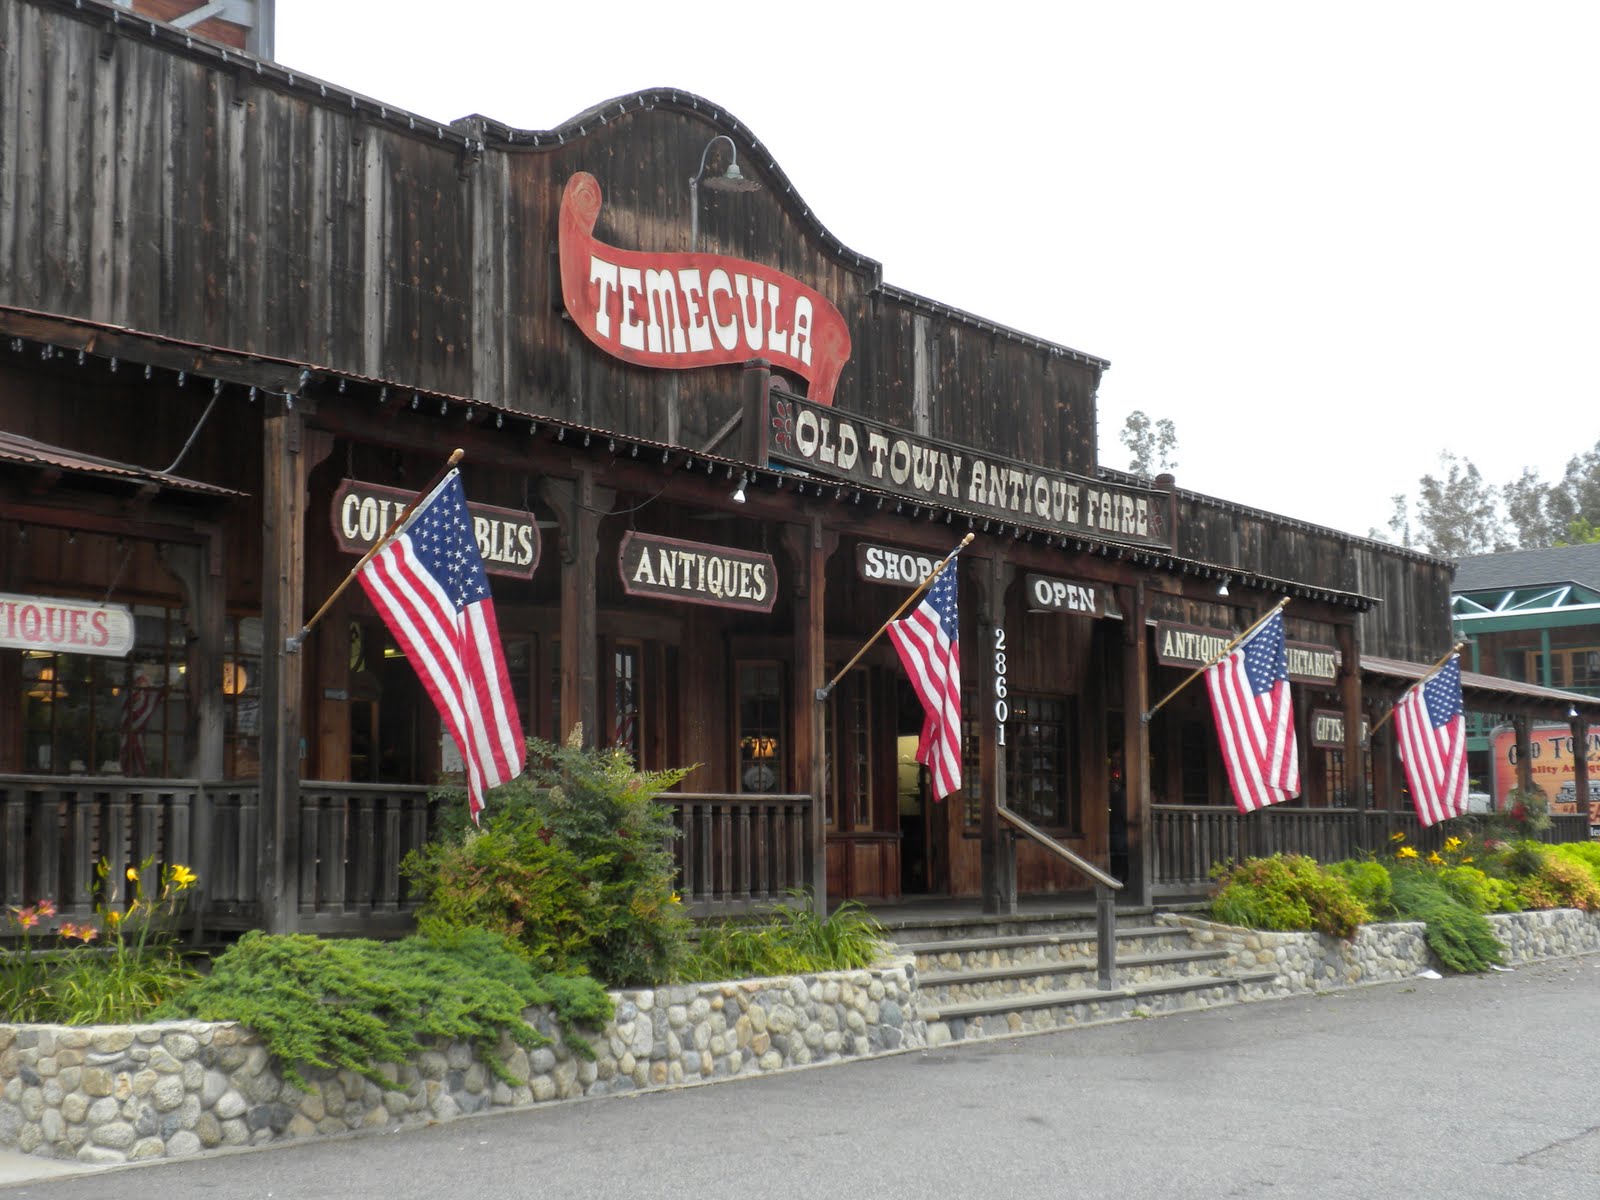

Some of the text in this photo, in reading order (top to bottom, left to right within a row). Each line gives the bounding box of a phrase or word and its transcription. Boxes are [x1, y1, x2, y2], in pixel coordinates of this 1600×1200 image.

[590, 256, 813, 366] TEMECULA
[795, 410, 1147, 537] OLD TOWN ANTIQUE FAIRE
[633, 547, 766, 601] ANTIQUES
[1034, 580, 1096, 614] OPEN
[0, 602, 110, 648] IQUES
[995, 628, 1008, 746] 28601
[1316, 717, 1342, 742] GIFTS
